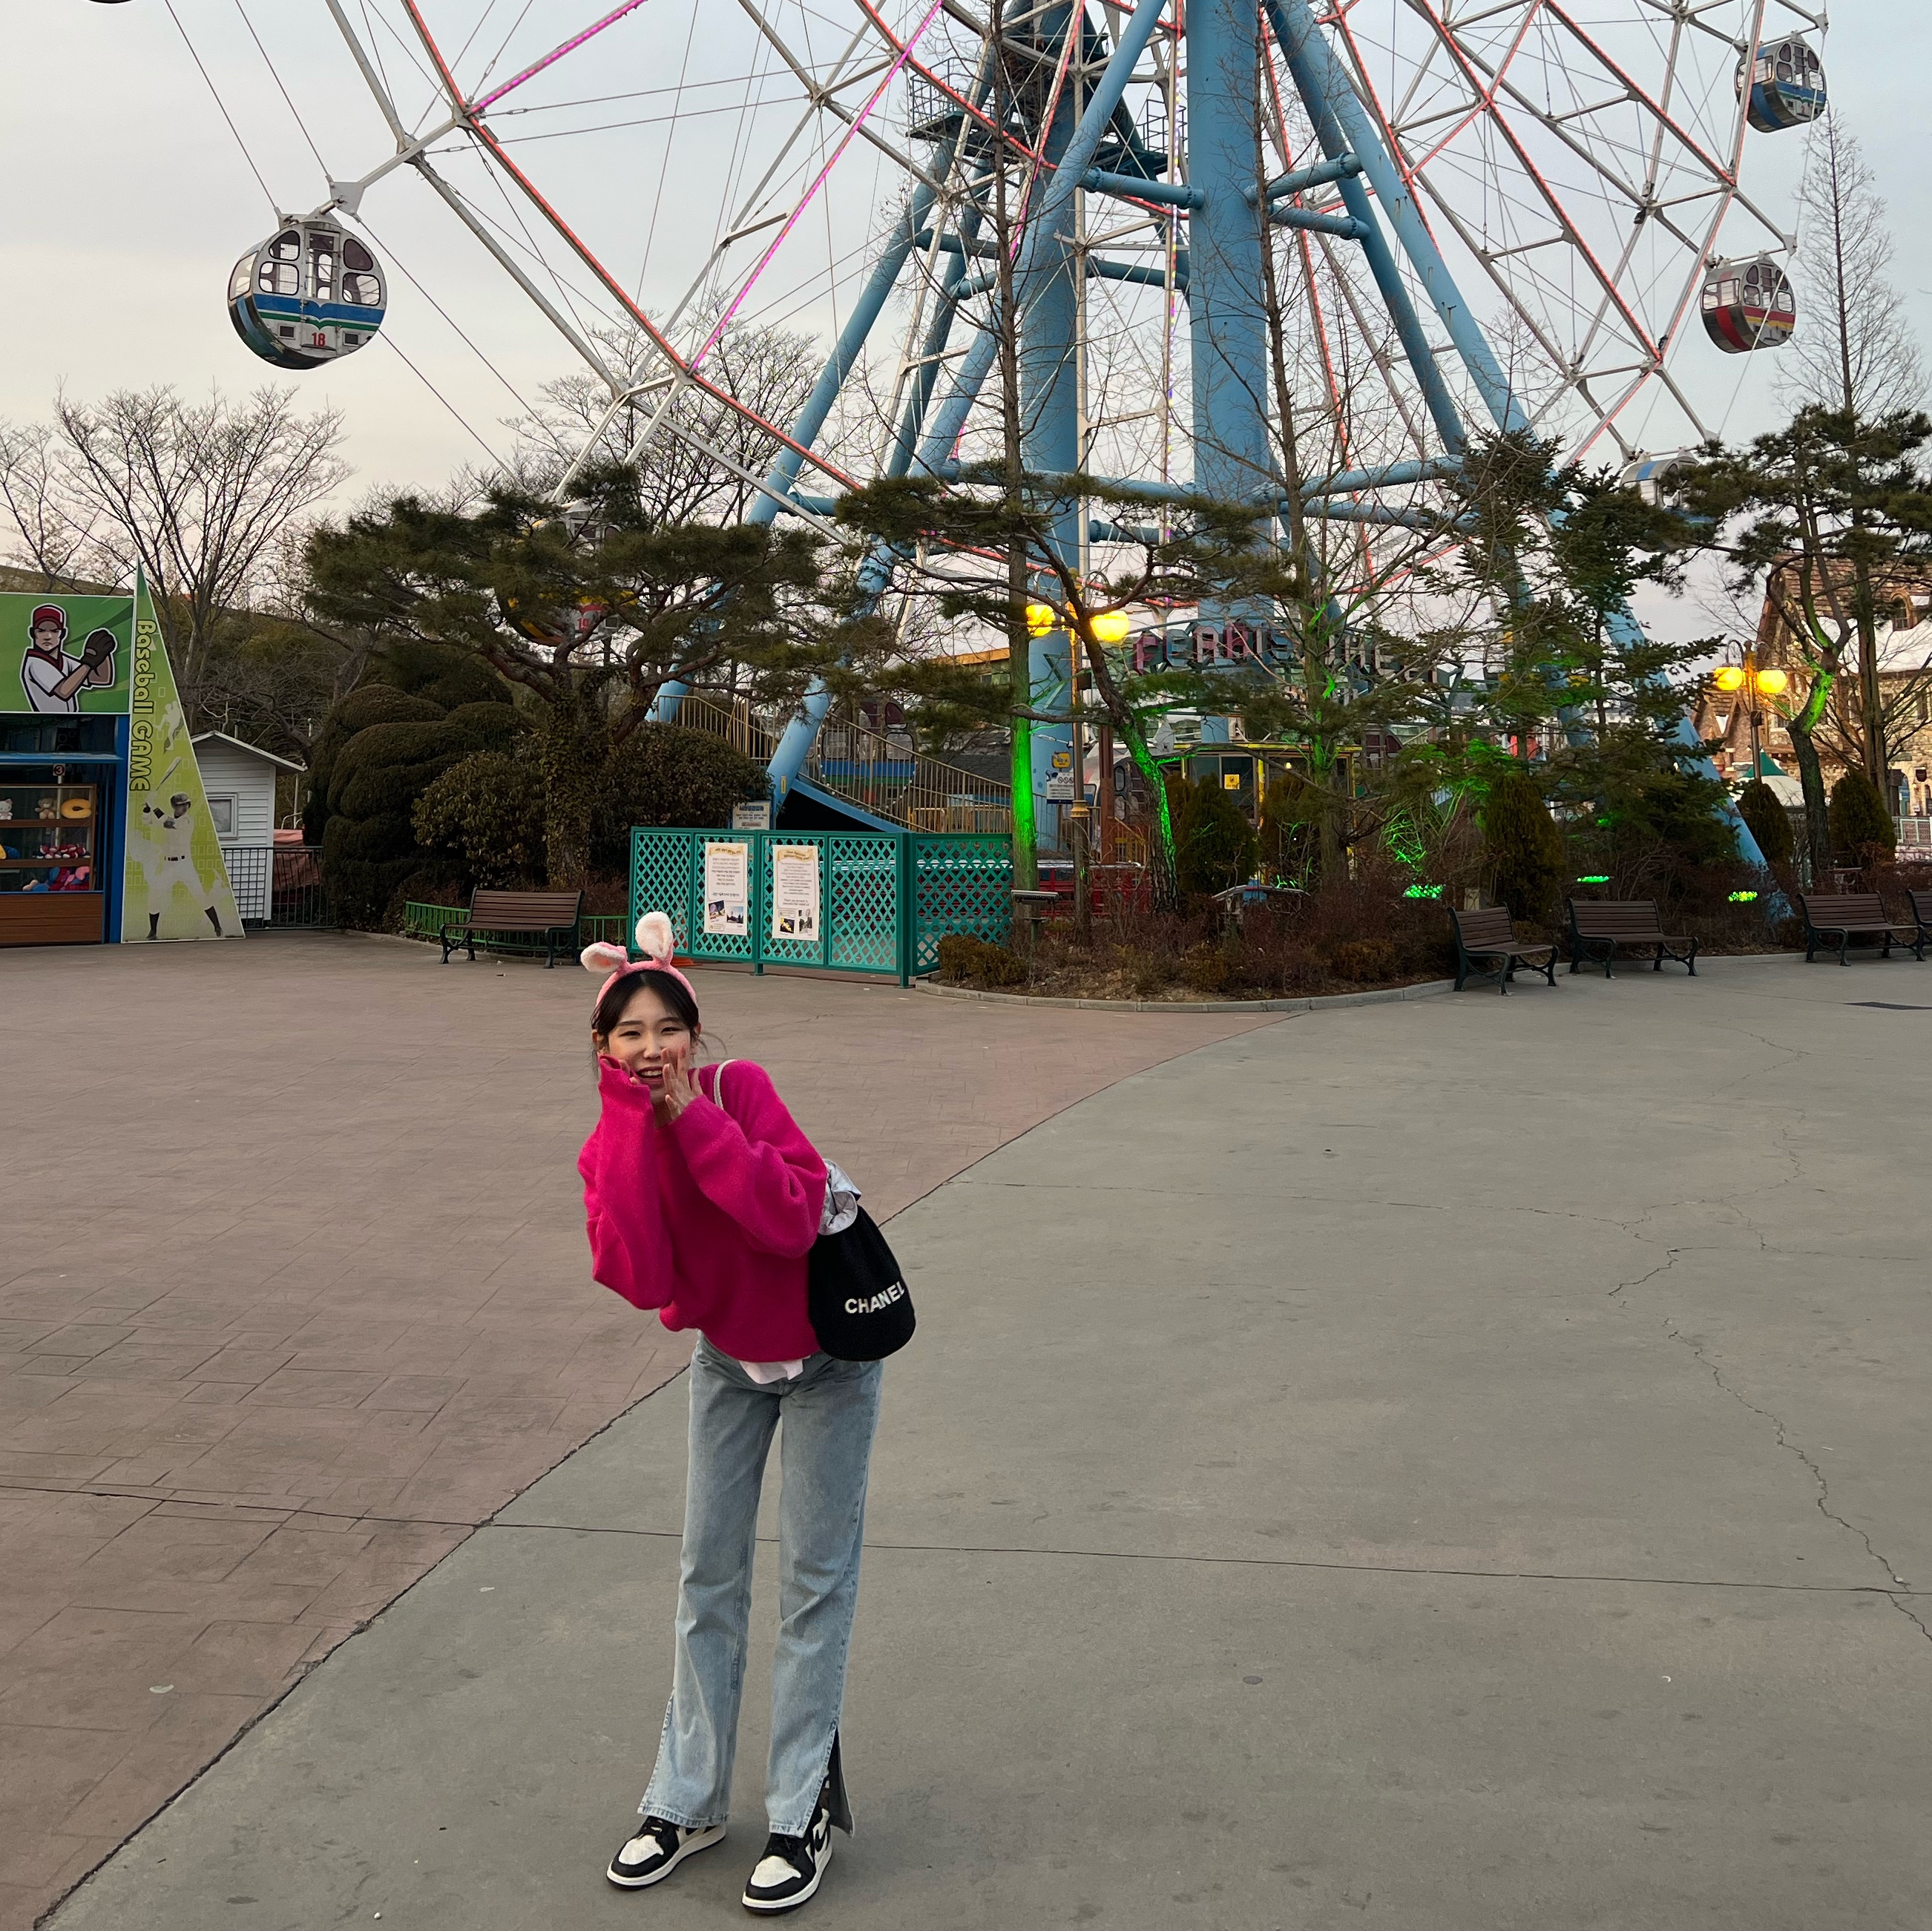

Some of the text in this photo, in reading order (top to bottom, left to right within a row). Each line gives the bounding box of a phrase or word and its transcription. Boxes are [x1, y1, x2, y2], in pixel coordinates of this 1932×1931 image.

[312, 332, 326, 347] 18
[129, 619, 157, 791] Baseball GAME
[55, 765, 64, 775] 3
[844, 1281, 905, 1314] CHANEL
